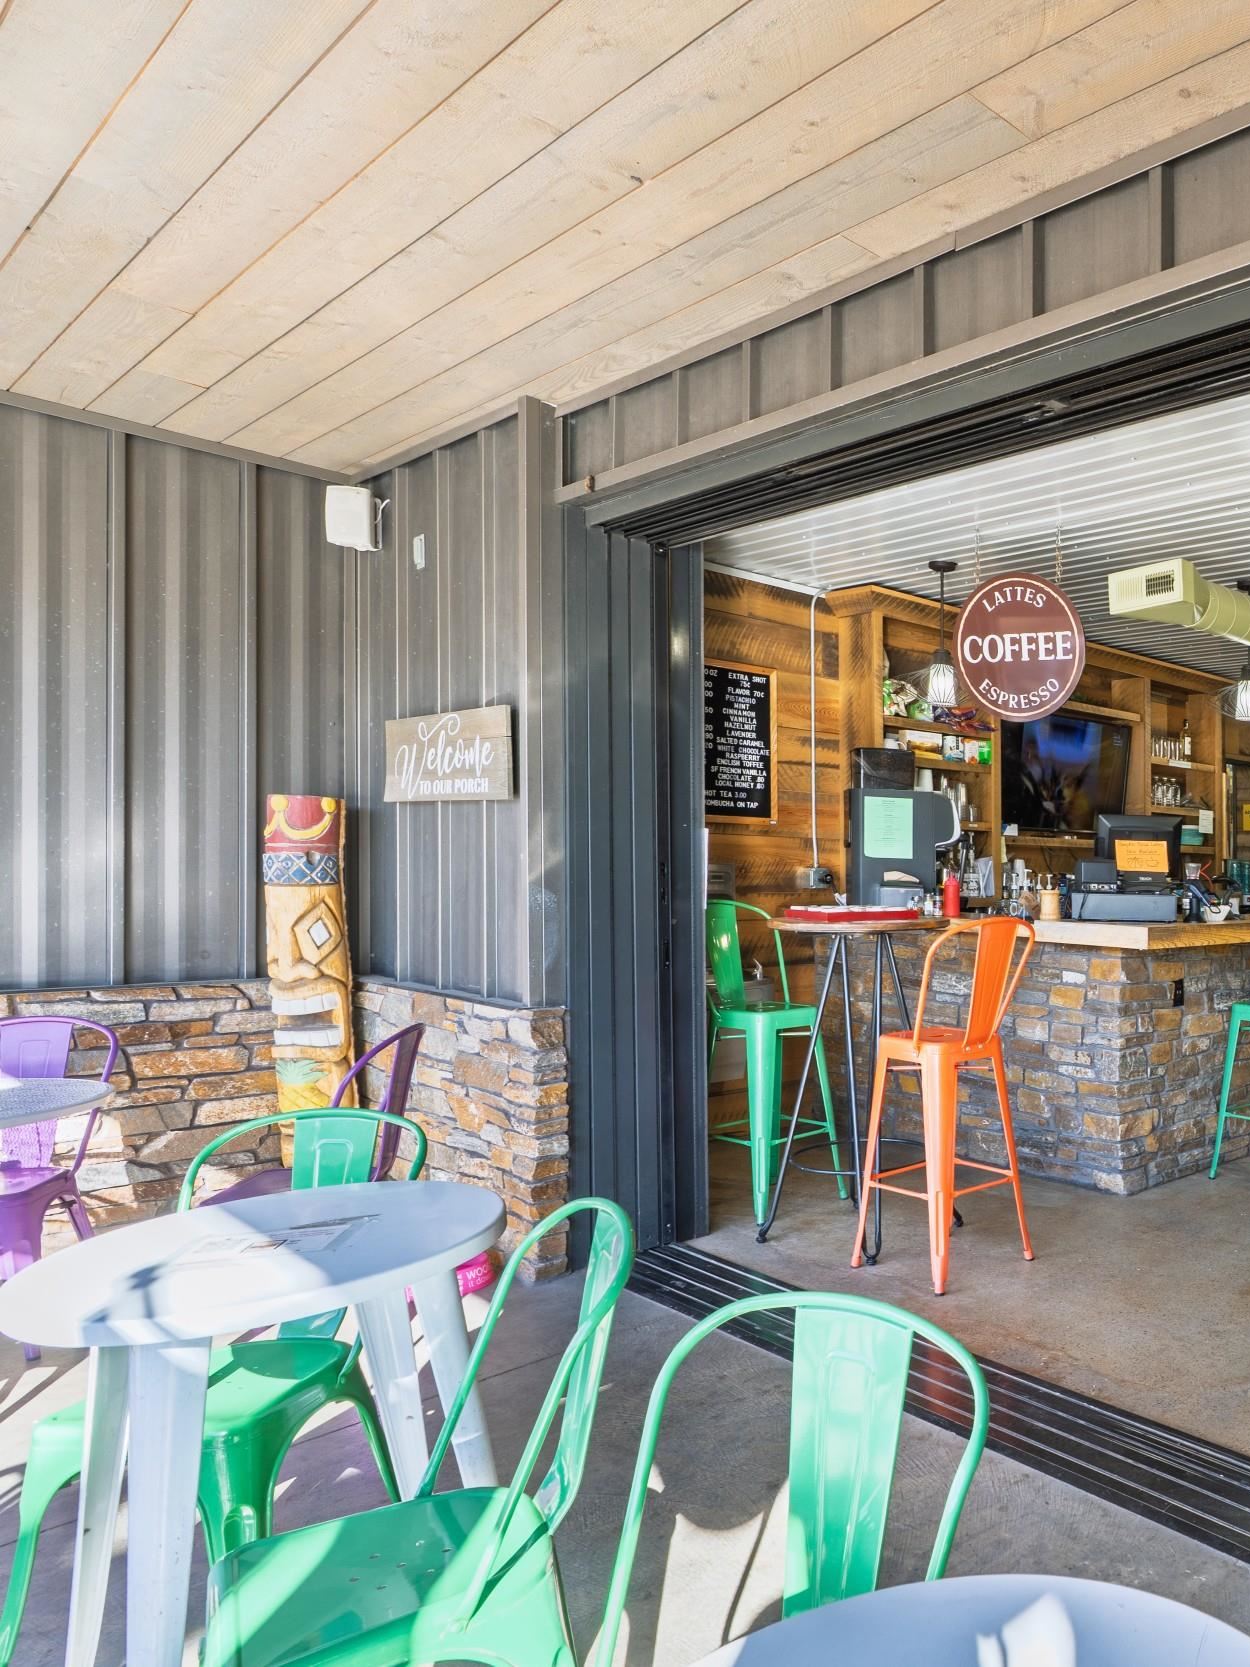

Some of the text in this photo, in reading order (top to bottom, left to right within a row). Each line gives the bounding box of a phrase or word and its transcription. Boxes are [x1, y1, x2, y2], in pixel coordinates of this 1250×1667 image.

[982, 587, 1046, 612] LATTES
[963, 631, 1073, 664] COFFEE
[728, 672, 767, 684] EXTRA SHOT
[727, 686, 751, 696] FLAVOR
[978, 678, 1059, 709] ESPRESSO
[725, 694, 756, 705] PISTACHIO
[733, 702, 750, 710] MINT
[722, 707, 756, 718] CINNAMON
[729, 715, 757, 724] VANILLA
[724, 721, 757, 731] HAZELNUT
[726, 730, 757, 739] LAVENDER
[716, 736, 765, 748] SALTED CARAMEL
[717, 744, 770, 756] WHITE CHOCOLATE
[394, 713, 495, 799] Welcome
[725, 752, 760, 762] RASPBERRY
[716, 758, 765, 769] ENGLISH TOFFEE
[719, 766, 742, 774] FRENCH
[742, 768, 767, 777] VANILLA
[717, 773, 752, 783] CHOCOLATE
[420, 778, 488, 795] TO OUR PORCH
[715, 780, 733, 788] LOCAL
[734, 781, 754, 789] HONEY
[719, 790, 733, 798] TEA
[705, 799, 734, 807] OMBUCHA
[746, 801, 759, 809] TAP
[466, 1263, 488, 1280] WOO
